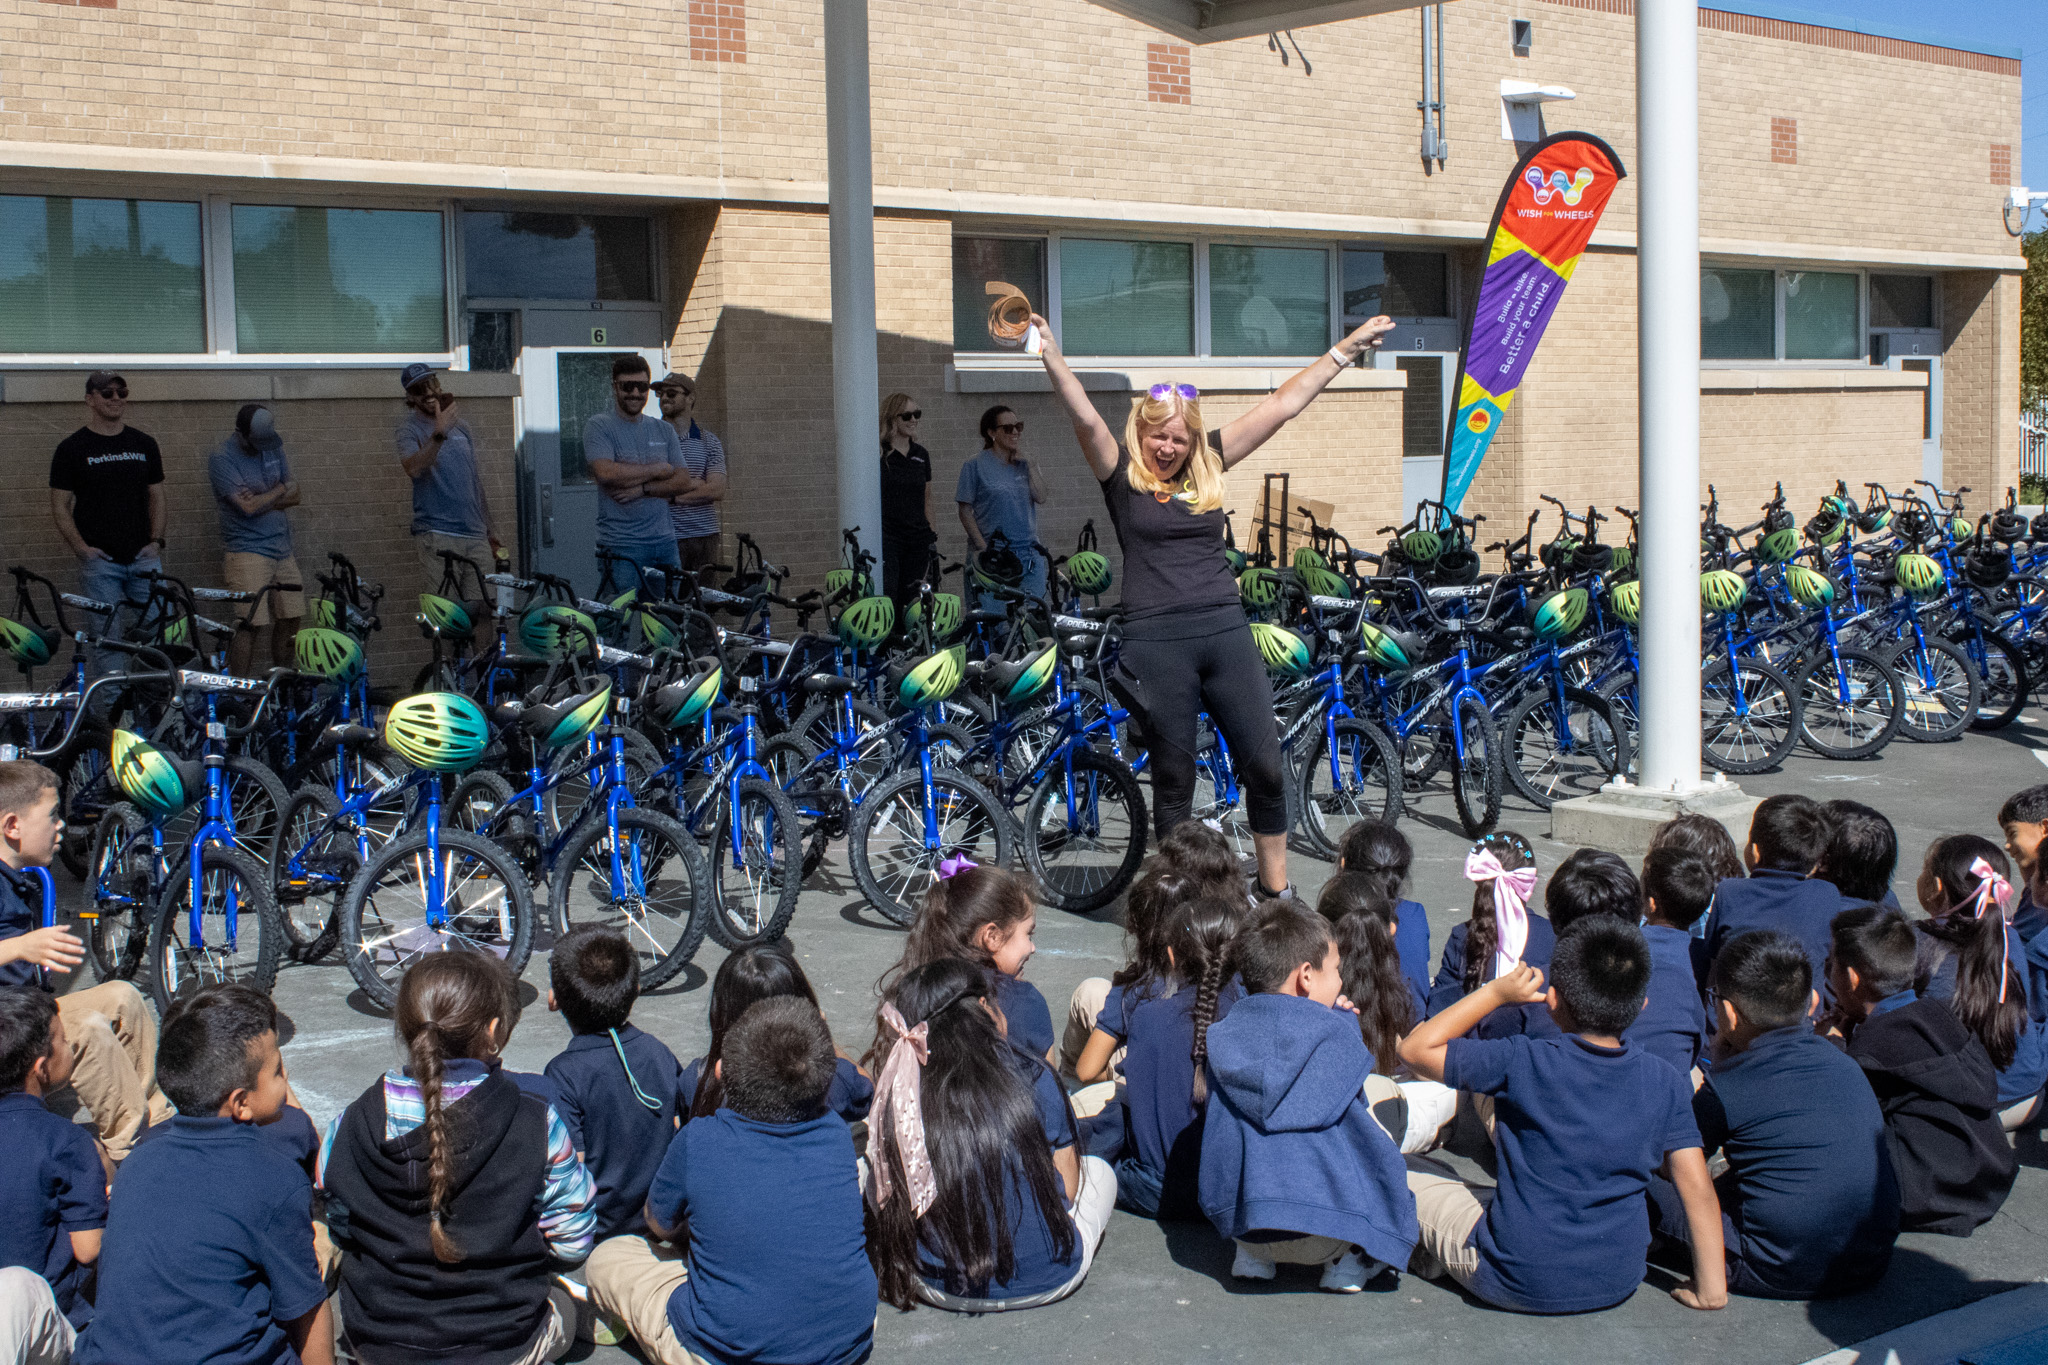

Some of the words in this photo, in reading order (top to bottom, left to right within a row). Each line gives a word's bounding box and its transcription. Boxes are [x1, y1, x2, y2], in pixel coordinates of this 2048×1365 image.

[1517, 209, 1542, 218] WISH
[1554, 210, 1594, 220] WHEELS
[1498, 299, 1512, 323] Build
[1514, 271, 1530, 292] bike.
[1500, 322, 1517, 346] Build
[1513, 300, 1526, 322] your
[1521, 275, 1538, 300] team.
[594, 329, 604, 343] 6
[1499, 331, 1526, 374] Better
[1522, 320, 1532, 329] a
[1529, 281, 1552, 317] child.
[1416, 339, 1423, 350] 5
[87, 452, 147, 466] Perkins&Will
[1288, 703, 1316, 738] HUFFY
[1416, 688, 1443, 721] HUFFY
